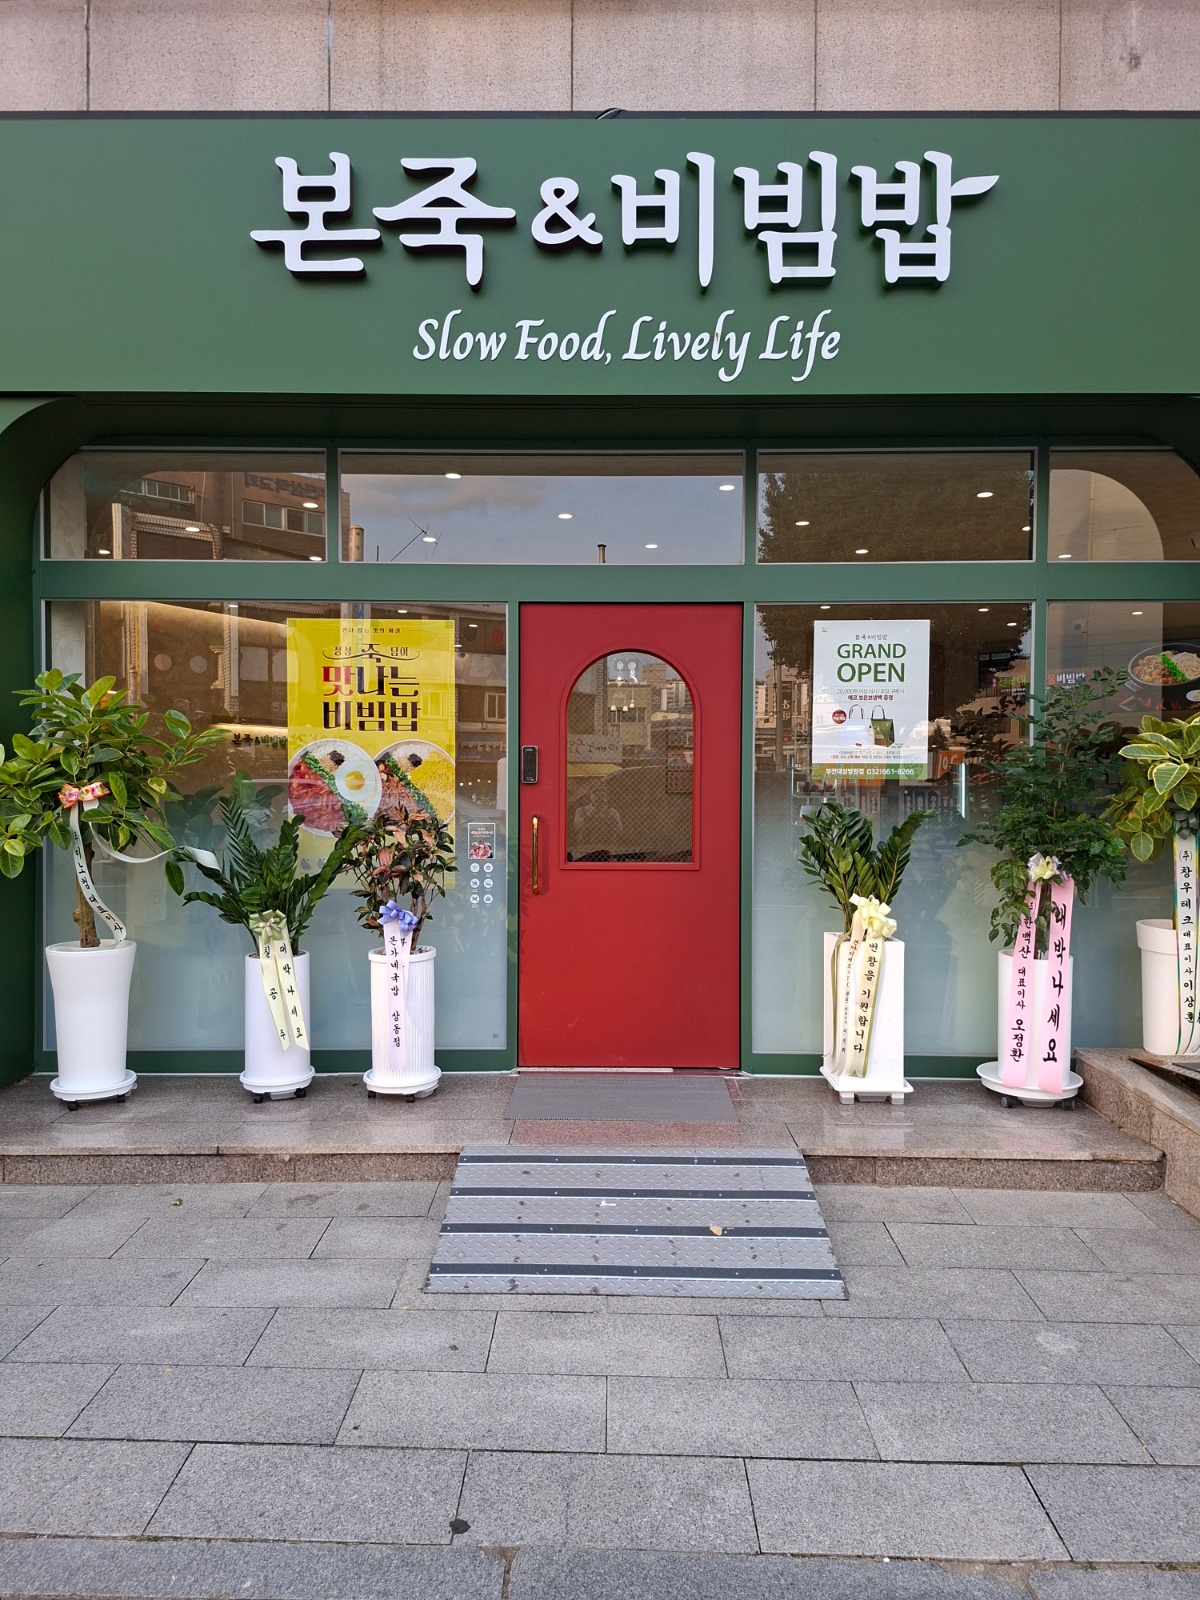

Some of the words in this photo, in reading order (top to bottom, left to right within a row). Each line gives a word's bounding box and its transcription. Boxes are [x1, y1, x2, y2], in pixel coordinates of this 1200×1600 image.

[412, 309, 507, 361] Slow
[513, 309, 615, 365] Food,
[622, 309, 752, 382] Lively
[759, 309, 841, 382] Life
[334, 646, 352, 656] 정성
[390, 646, 409, 657] 담아
[837, 643, 907, 659] GRAND
[322, 666, 420, 697] 맛나는
[837, 662, 905, 683] OPEN
[322, 701, 422, 732] 비빔밥
[388, 935, 400, 997] 본가네국밥
[863, 942, 879, 982] 번창을
[1183, 930, 1193, 976] 대표이사
[279, 942, 303, 1039] 대박나세요
[1016, 966, 1027, 1011] 대표이사
[391, 1010, 402, 1048] 상동점
[853, 988, 871, 1054] 기원합니다
[1010, 1018, 1026, 1062] 오정환
